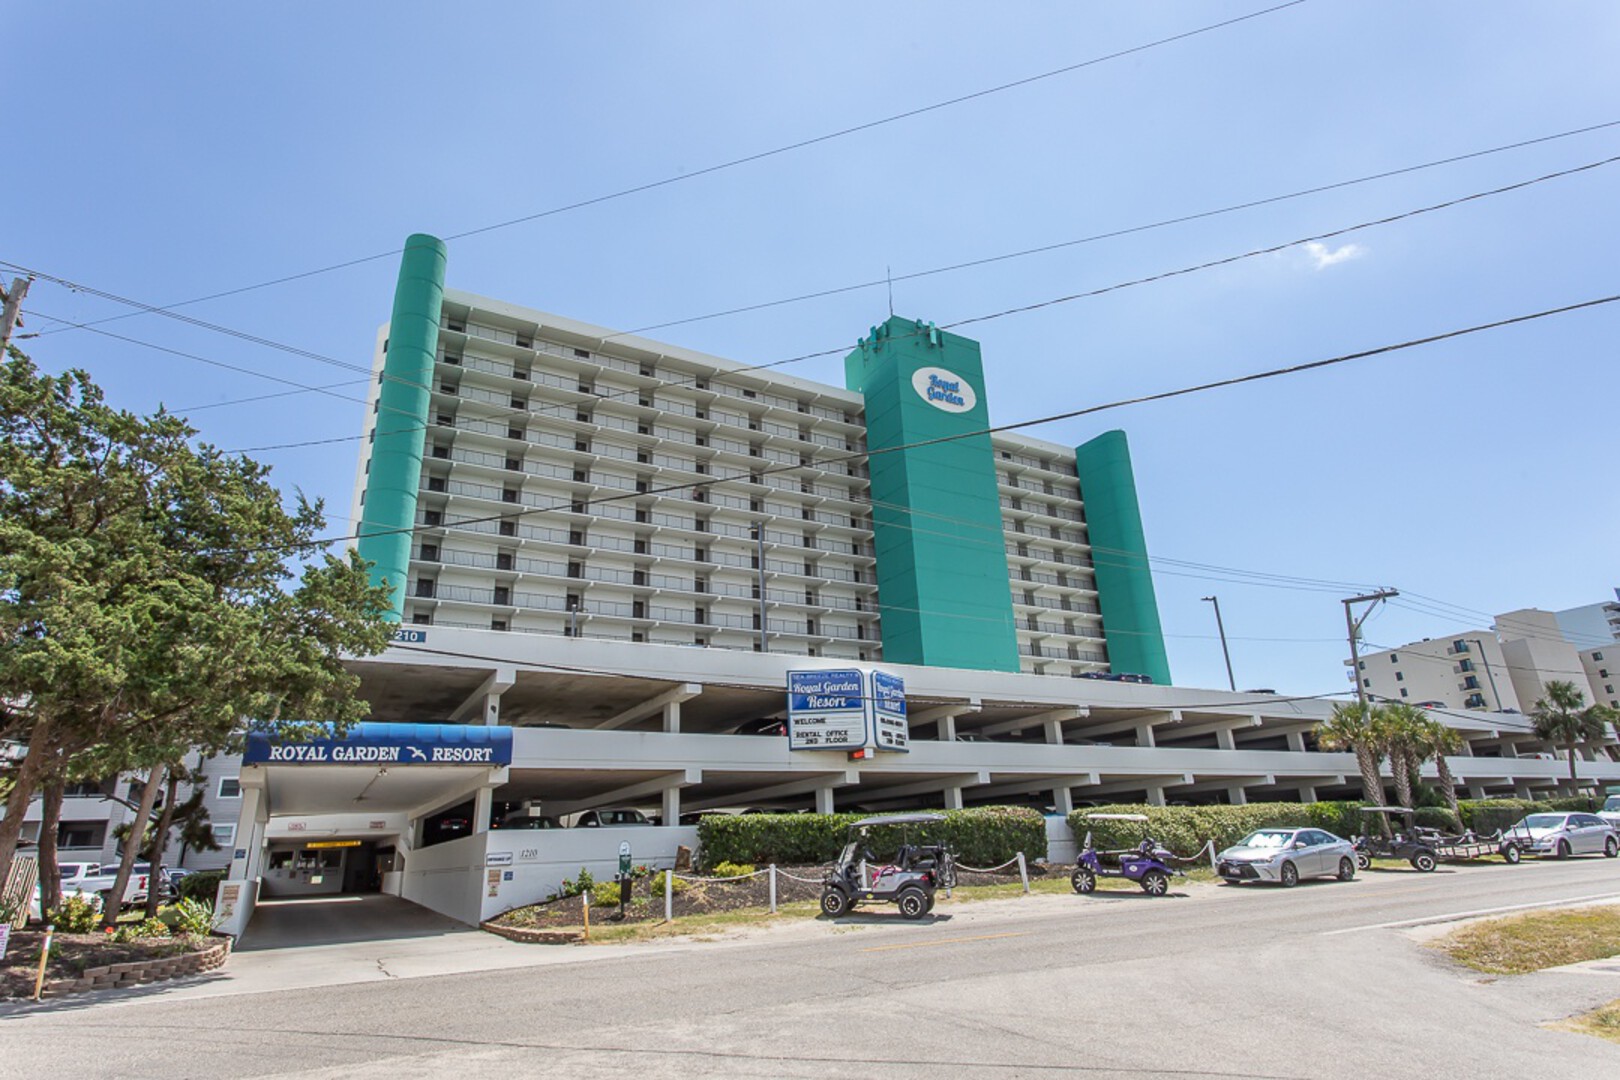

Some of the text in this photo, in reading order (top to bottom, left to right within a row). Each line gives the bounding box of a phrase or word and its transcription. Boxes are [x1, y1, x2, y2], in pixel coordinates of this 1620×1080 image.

[928, 374, 959, 393] Royal
[927, 386, 964, 406] Garden
[794, 680, 859, 695] Royal Garden
[807, 695, 847, 709] Resort
[793, 717, 826, 725] WELCOME
[269, 745, 493, 762] ROYAL GARDEN RESORT
